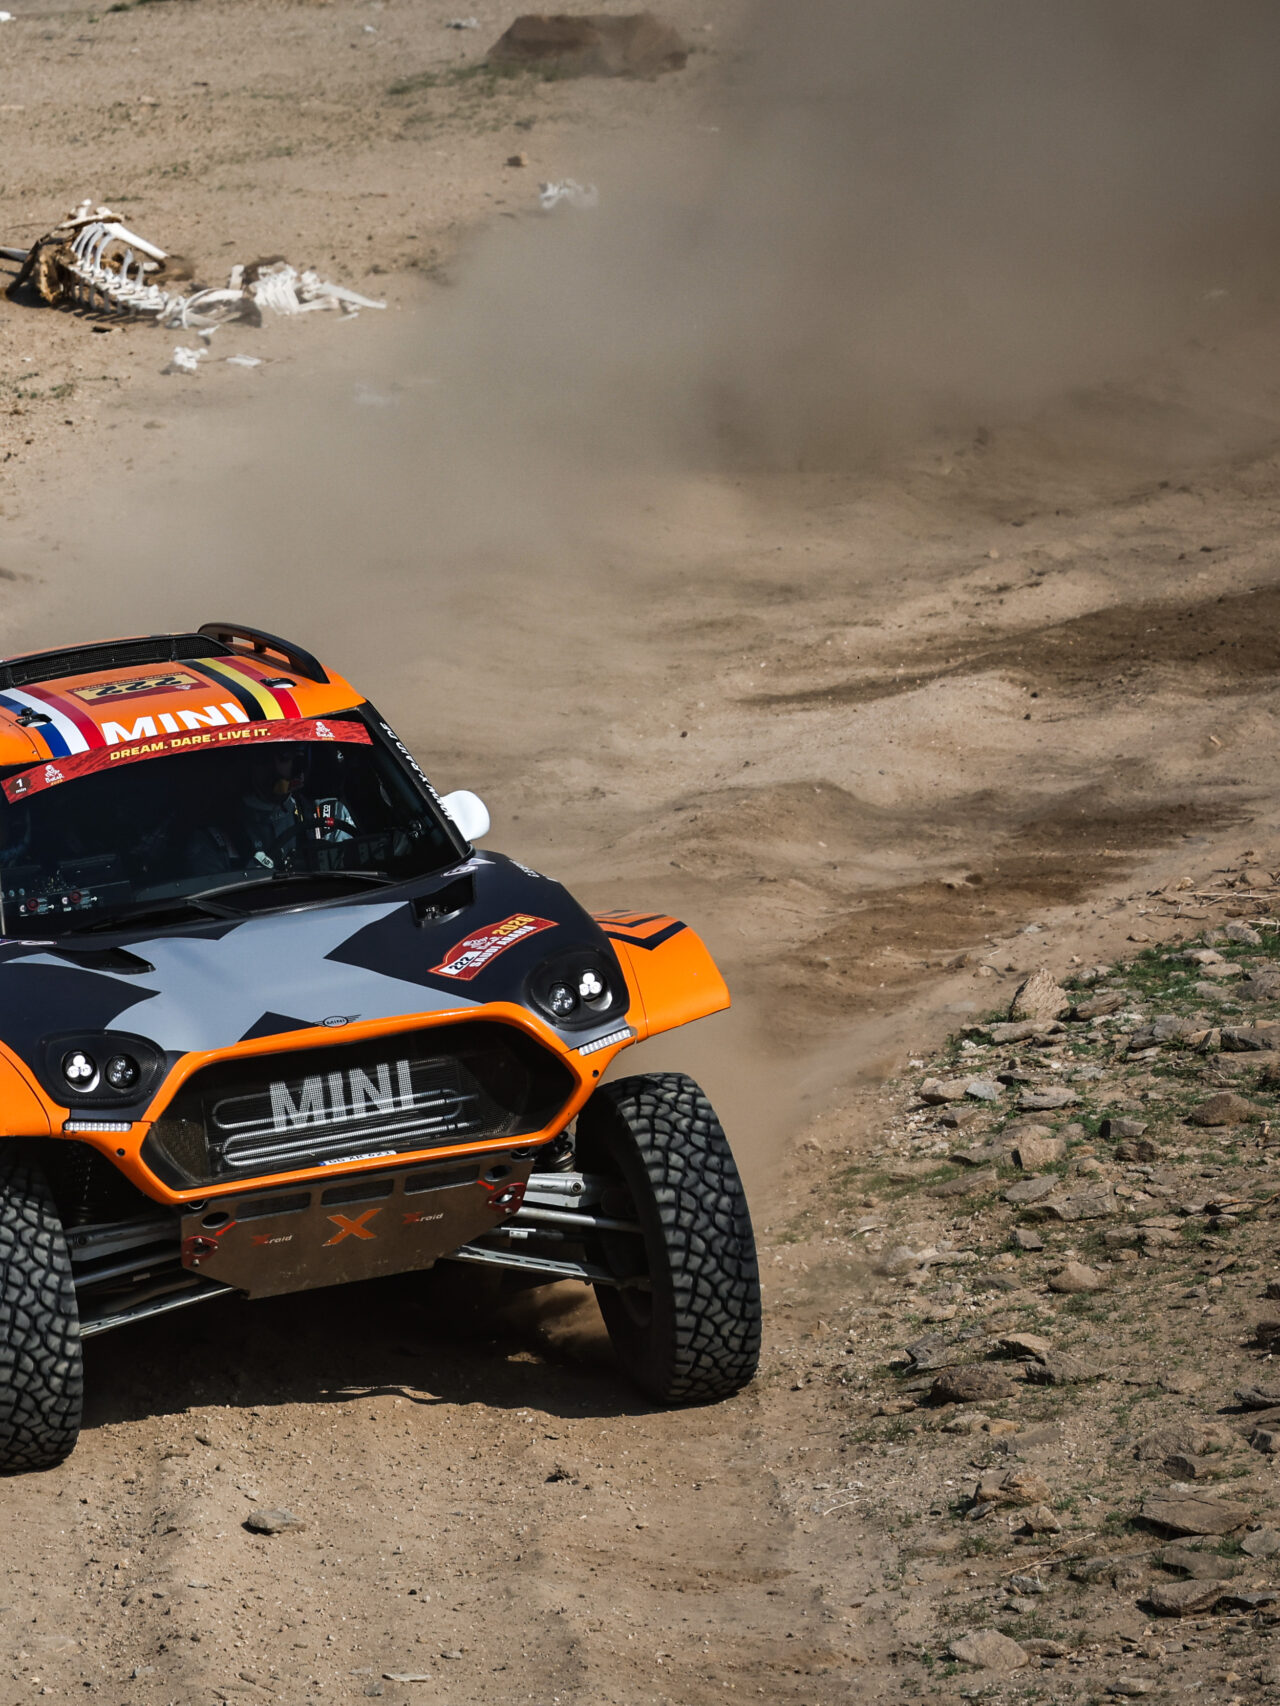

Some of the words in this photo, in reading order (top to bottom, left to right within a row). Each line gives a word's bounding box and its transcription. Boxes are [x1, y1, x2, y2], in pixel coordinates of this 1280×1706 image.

[88, 676, 182, 697] 222
[100, 702, 250, 746] MINI
[109, 741, 169, 761] DREAM.
[171, 734, 216, 748] DARE.
[218, 730, 251, 741] LIVE
[254, 728, 272, 737] IT.
[15, 778, 23, 788] 1
[491, 916, 536, 936] 2026
[468, 945, 502, 968] SAUDI
[496, 925, 538, 946] ARABIA
[448, 956, 475, 971] 222
[269, 1059, 415, 1132] MINI
